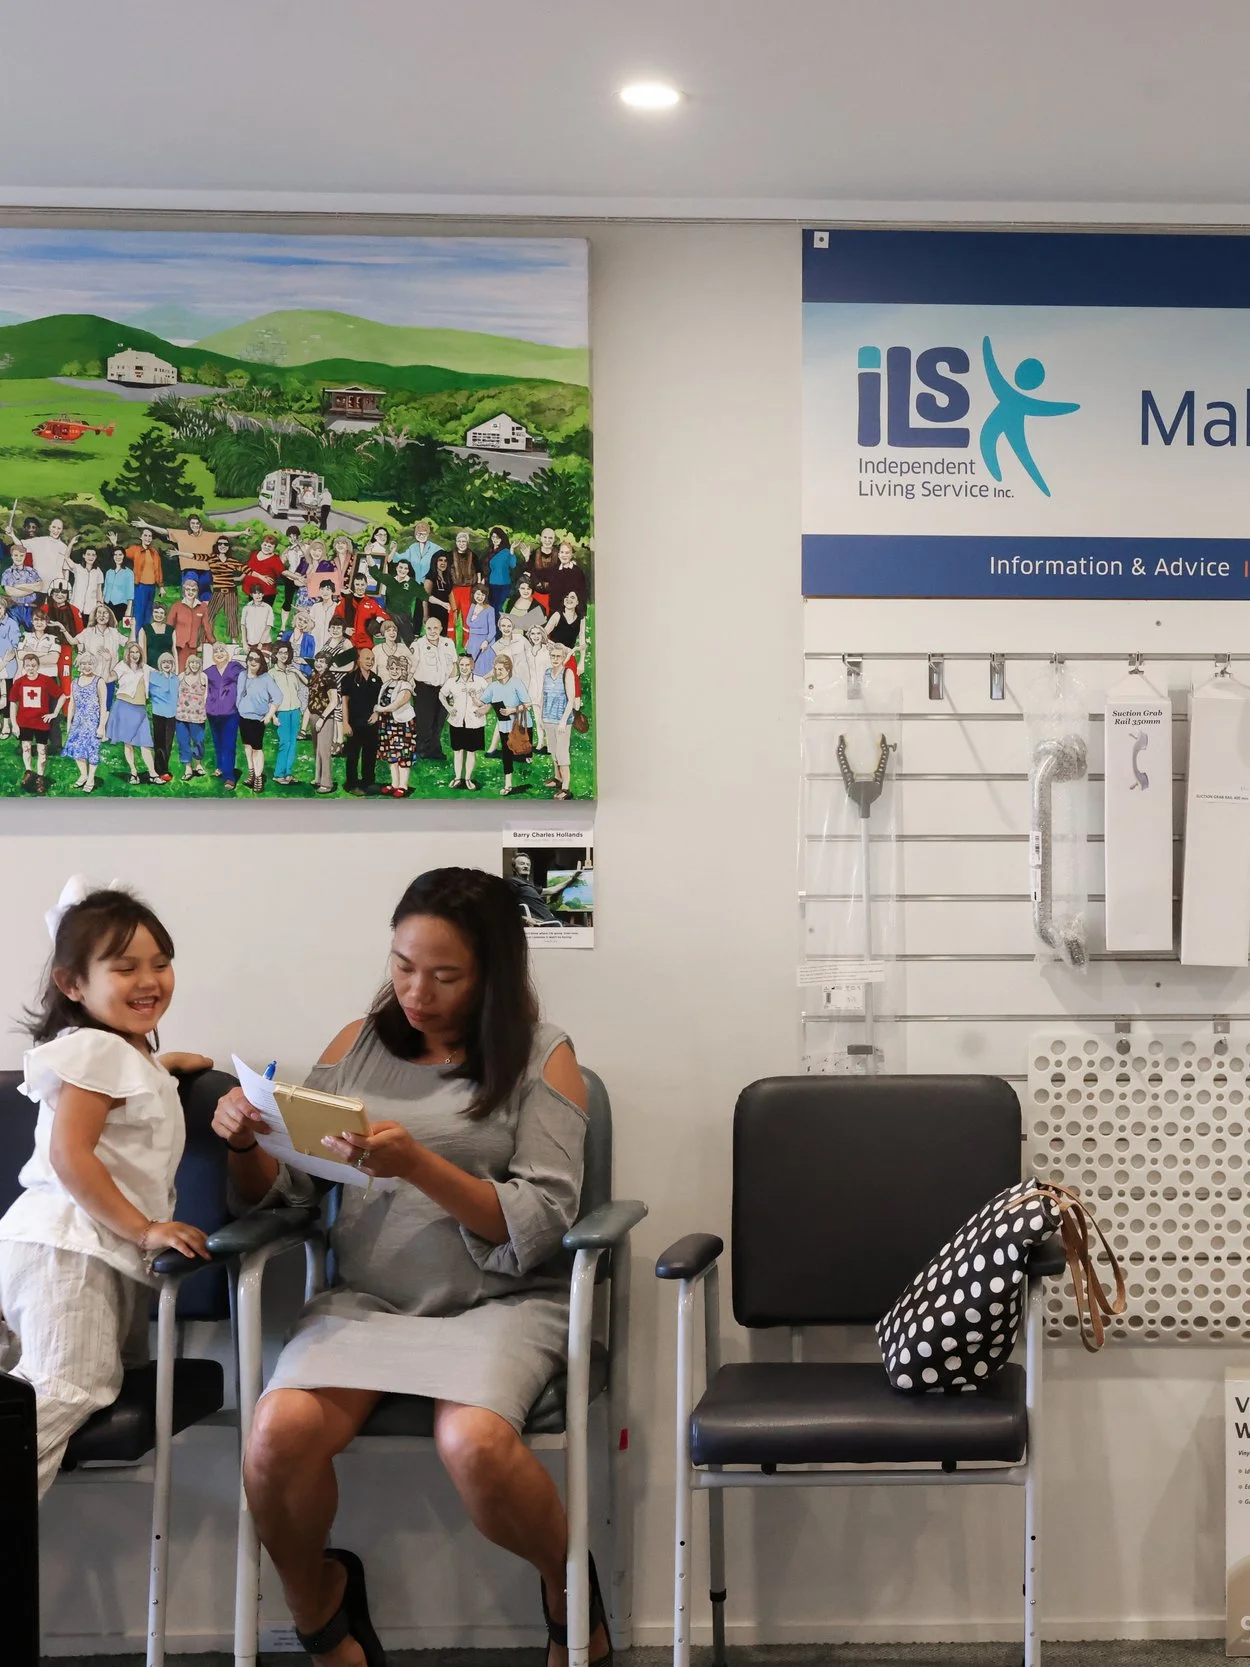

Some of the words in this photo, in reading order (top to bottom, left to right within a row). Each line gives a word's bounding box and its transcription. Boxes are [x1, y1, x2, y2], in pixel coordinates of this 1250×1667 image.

[858, 457, 977, 478] Independent
[858, 479, 916, 500] Living
[920, 480, 990, 499] Service
[993, 486, 1015, 499] Inc.
[989, 554, 1124, 578] Information
[1131, 556, 1147, 577] &
[1154, 556, 1231, 577] Advice
